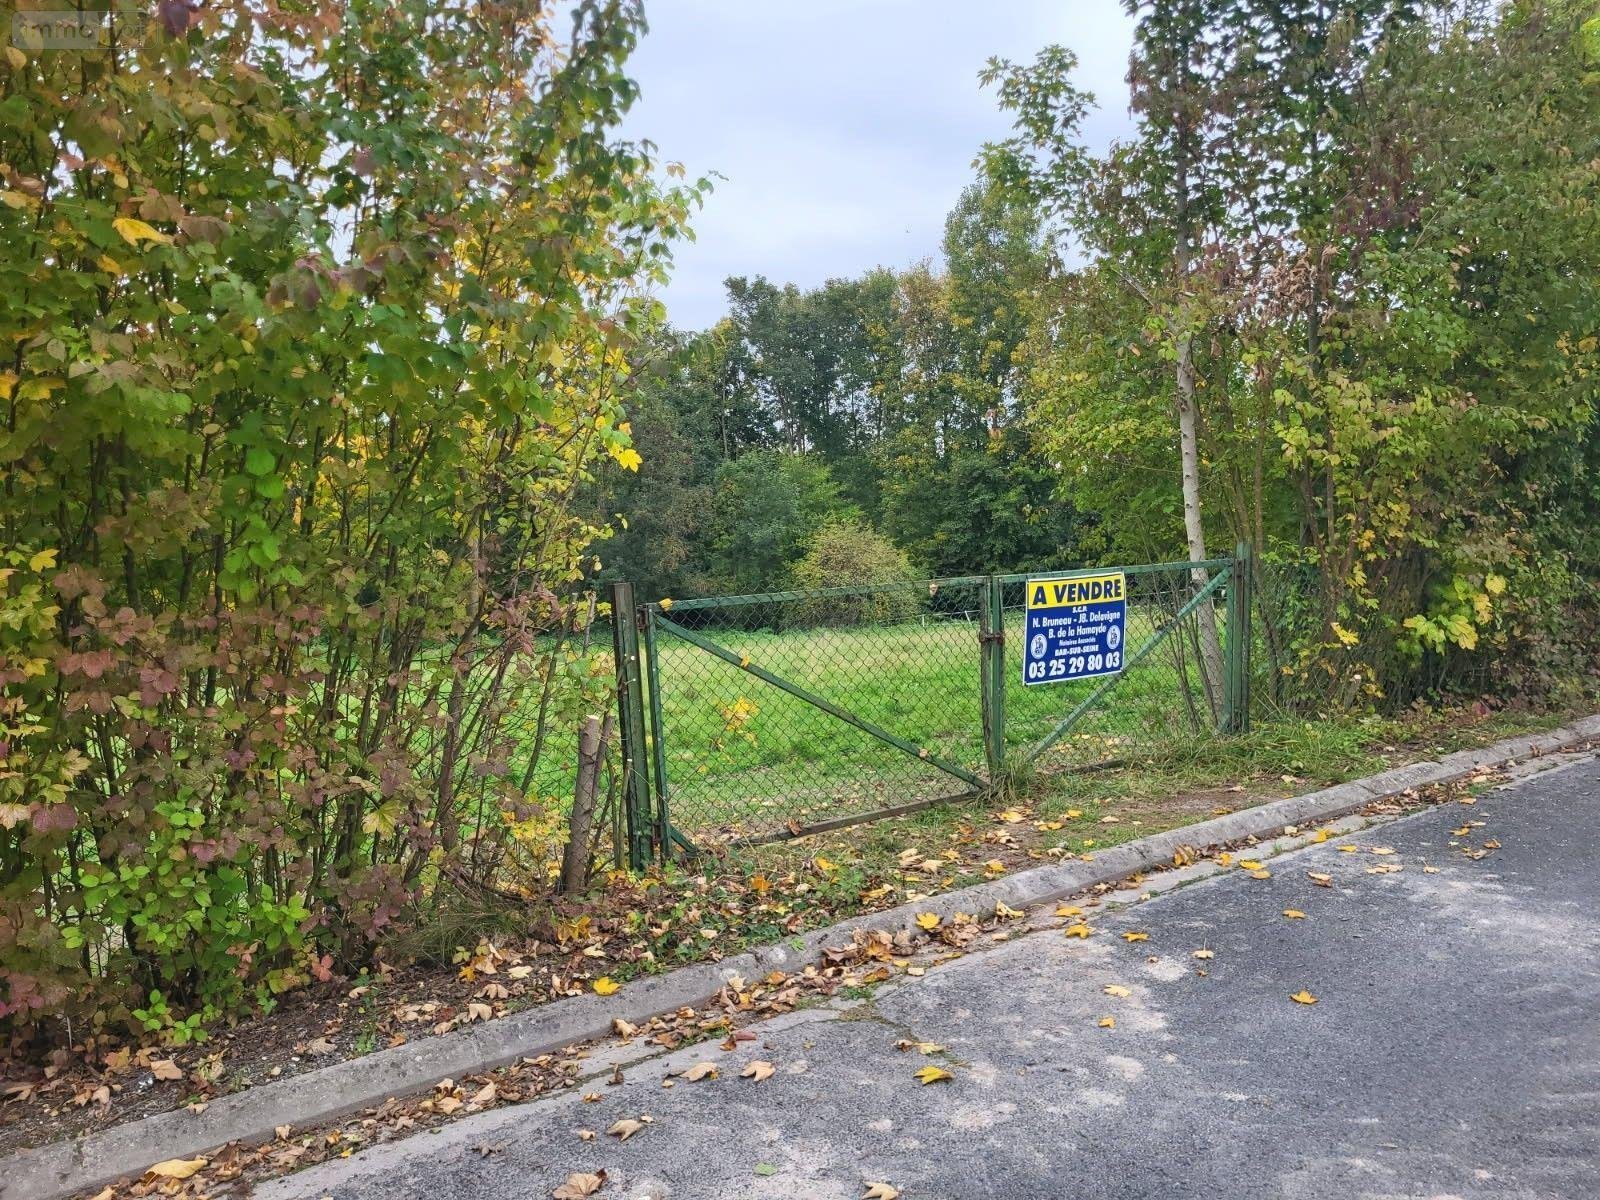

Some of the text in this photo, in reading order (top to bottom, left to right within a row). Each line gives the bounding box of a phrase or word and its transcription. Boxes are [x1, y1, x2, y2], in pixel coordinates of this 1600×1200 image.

[1032, 579, 1122, 605] A VENDRE
[1032, 618, 1041, 628] N.
[1042, 616, 1072, 627] Bruneau
[1089, 611, 1121, 622] Delavigne
[1048, 629, 1056, 639] B.
[1057, 627, 1067, 637] de
[1068, 627, 1075, 637] la
[1055, 645, 1099, 656] BAR-SUR-SEINE
[1029, 652, 1120, 678] 03 25 29 80 03
